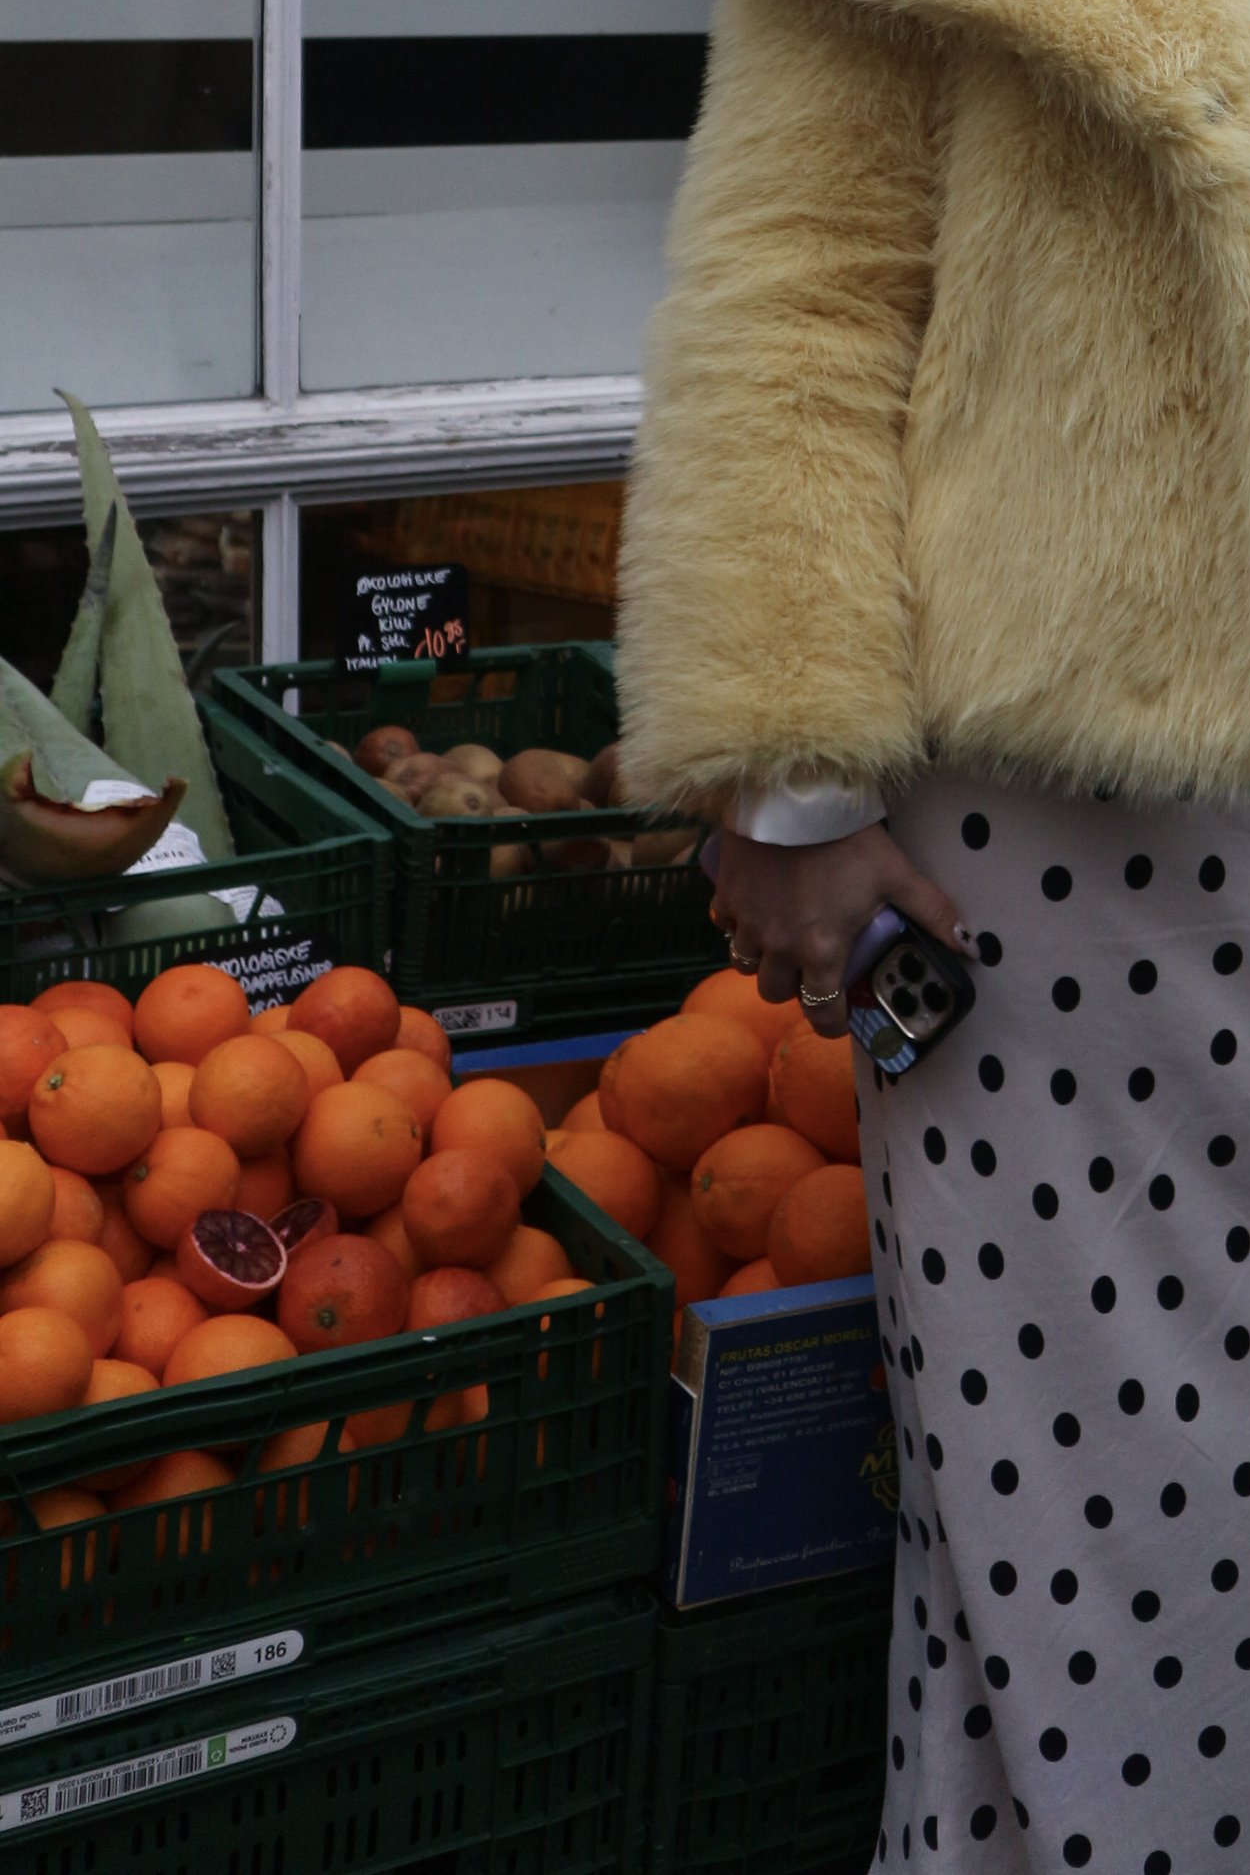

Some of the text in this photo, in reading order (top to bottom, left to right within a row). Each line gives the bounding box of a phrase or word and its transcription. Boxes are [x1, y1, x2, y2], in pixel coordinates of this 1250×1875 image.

[202, 939, 313, 977] OLOGISKE
[719, 1344, 771, 1364] FRUTAS
[774, 1336, 820, 1354] OSCAR
[253, 1641, 287, 1664] 186
[19, 1711, 42, 1722] POOL
[240, 1731, 269, 1744] SYSTEM
[229, 1743, 250, 1754] POOL
